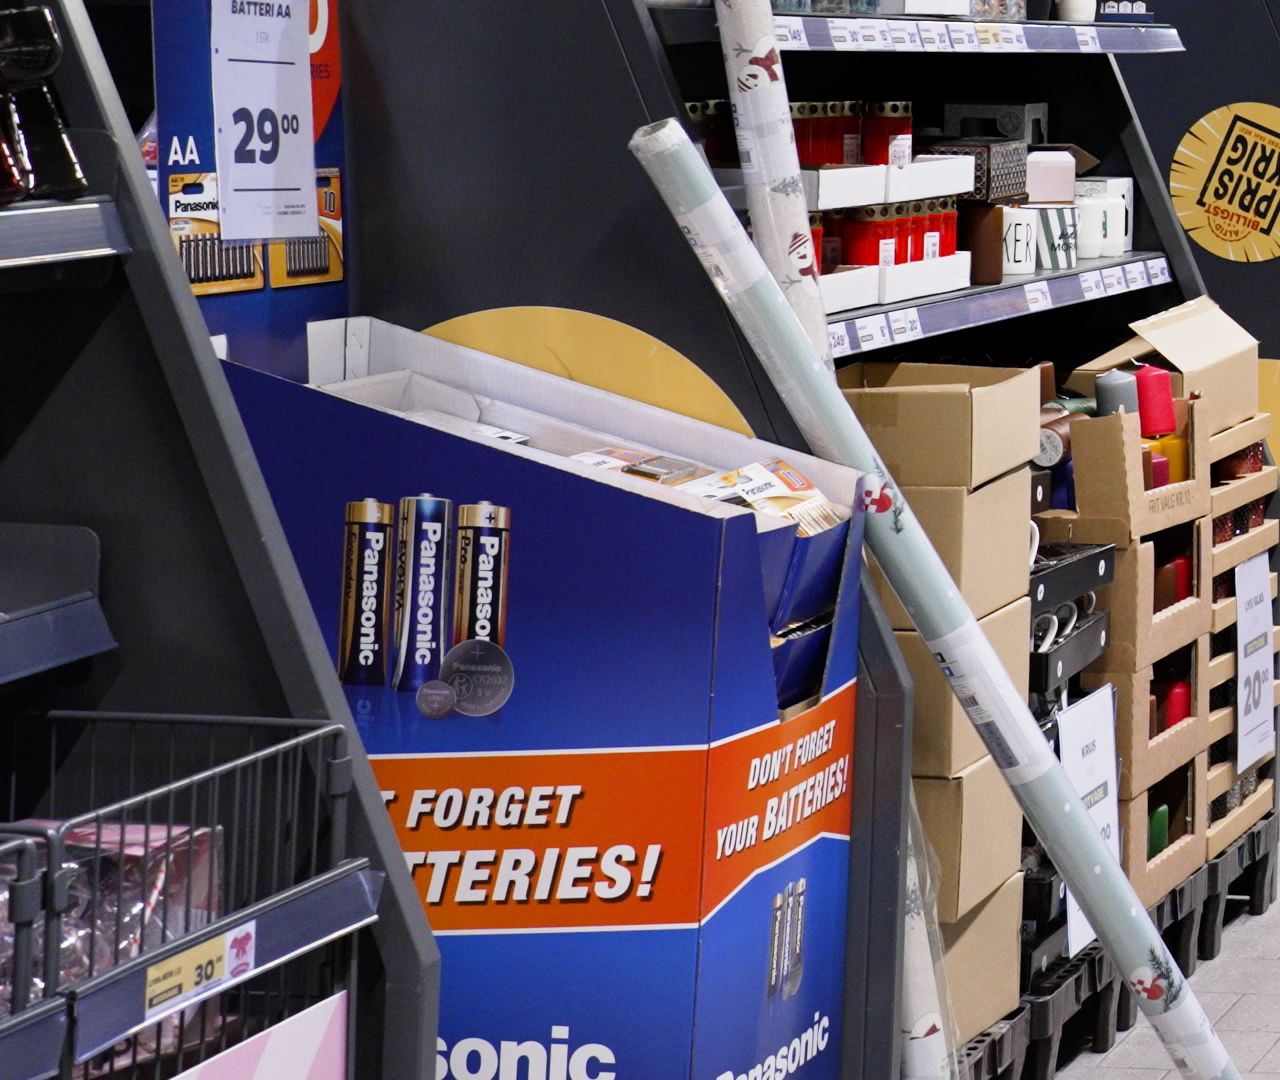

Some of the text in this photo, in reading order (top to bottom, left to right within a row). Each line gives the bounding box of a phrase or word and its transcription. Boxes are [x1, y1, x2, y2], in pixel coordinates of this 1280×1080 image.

[230, 0, 292, 19] BATTERI AA
[168, 135, 200, 166] AA
[1204, 202, 1261, 231] BILLIGST
[1213, 168, 1278, 220] PRIS
[1214, 222, 1240, 239] ALTID
[358, 531, 384, 666] Panasonic
[415, 521, 442, 666] Panasonic
[747, 719, 837, 791] DON'T FORGET
[1081, 738, 1097, 759] KRUS
[405, 783, 583, 829] FORGET
[715, 753, 850, 861] YOUR BATTERIES!
[410, 843, 664, 905] TERIES!
